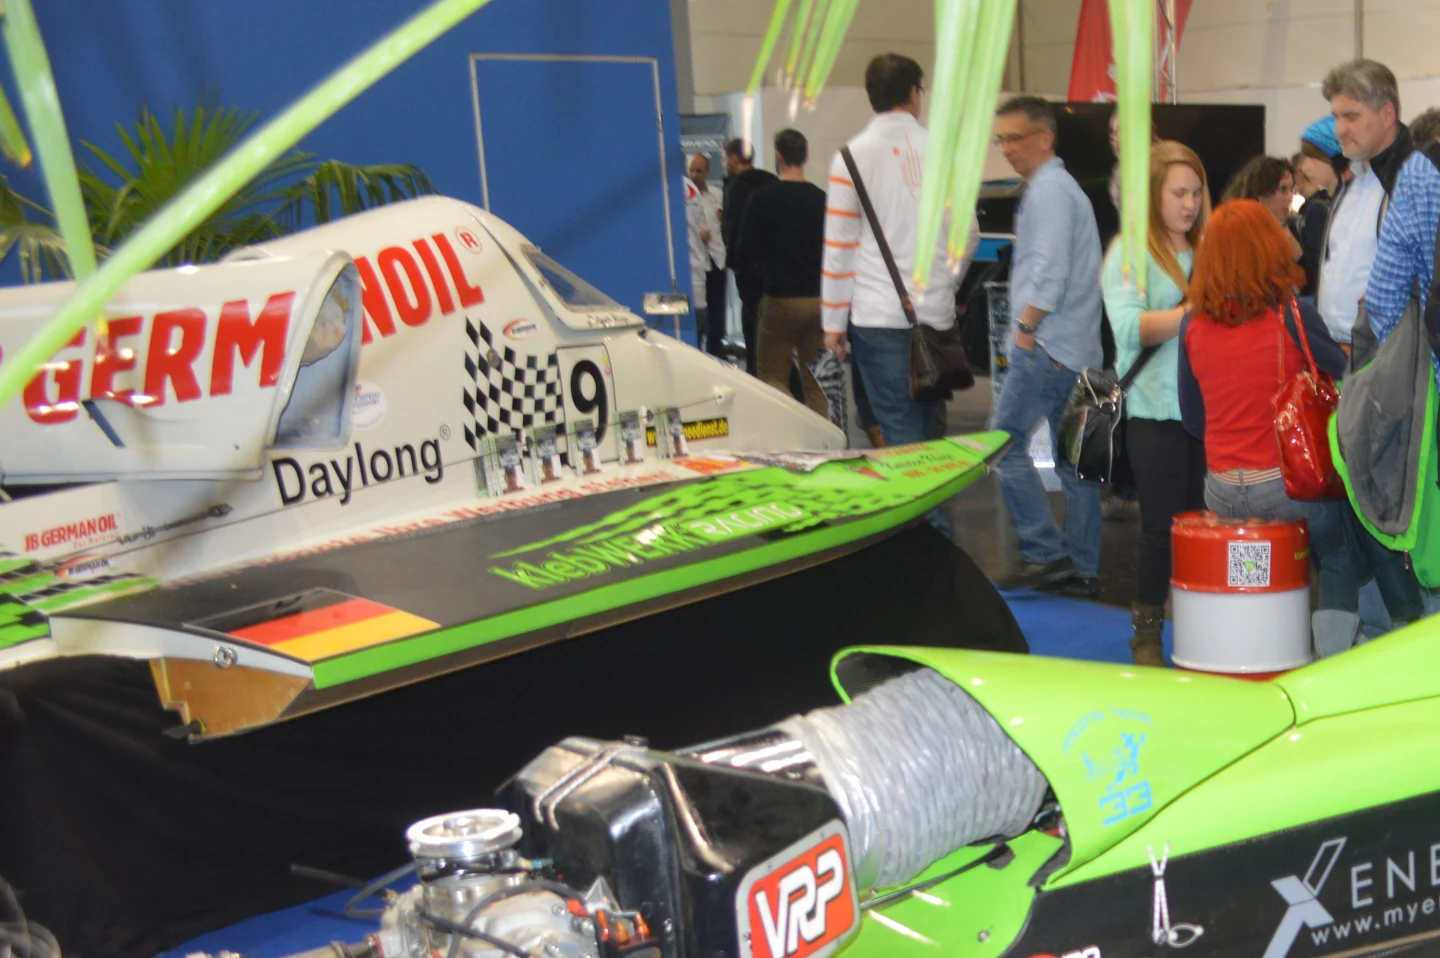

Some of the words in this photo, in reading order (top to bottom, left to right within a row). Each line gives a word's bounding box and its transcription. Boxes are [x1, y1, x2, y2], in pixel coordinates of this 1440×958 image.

[570, 359, 609, 447] 9
[271, 437, 445, 506] Daylong
[24, 533, 39, 553] JB
